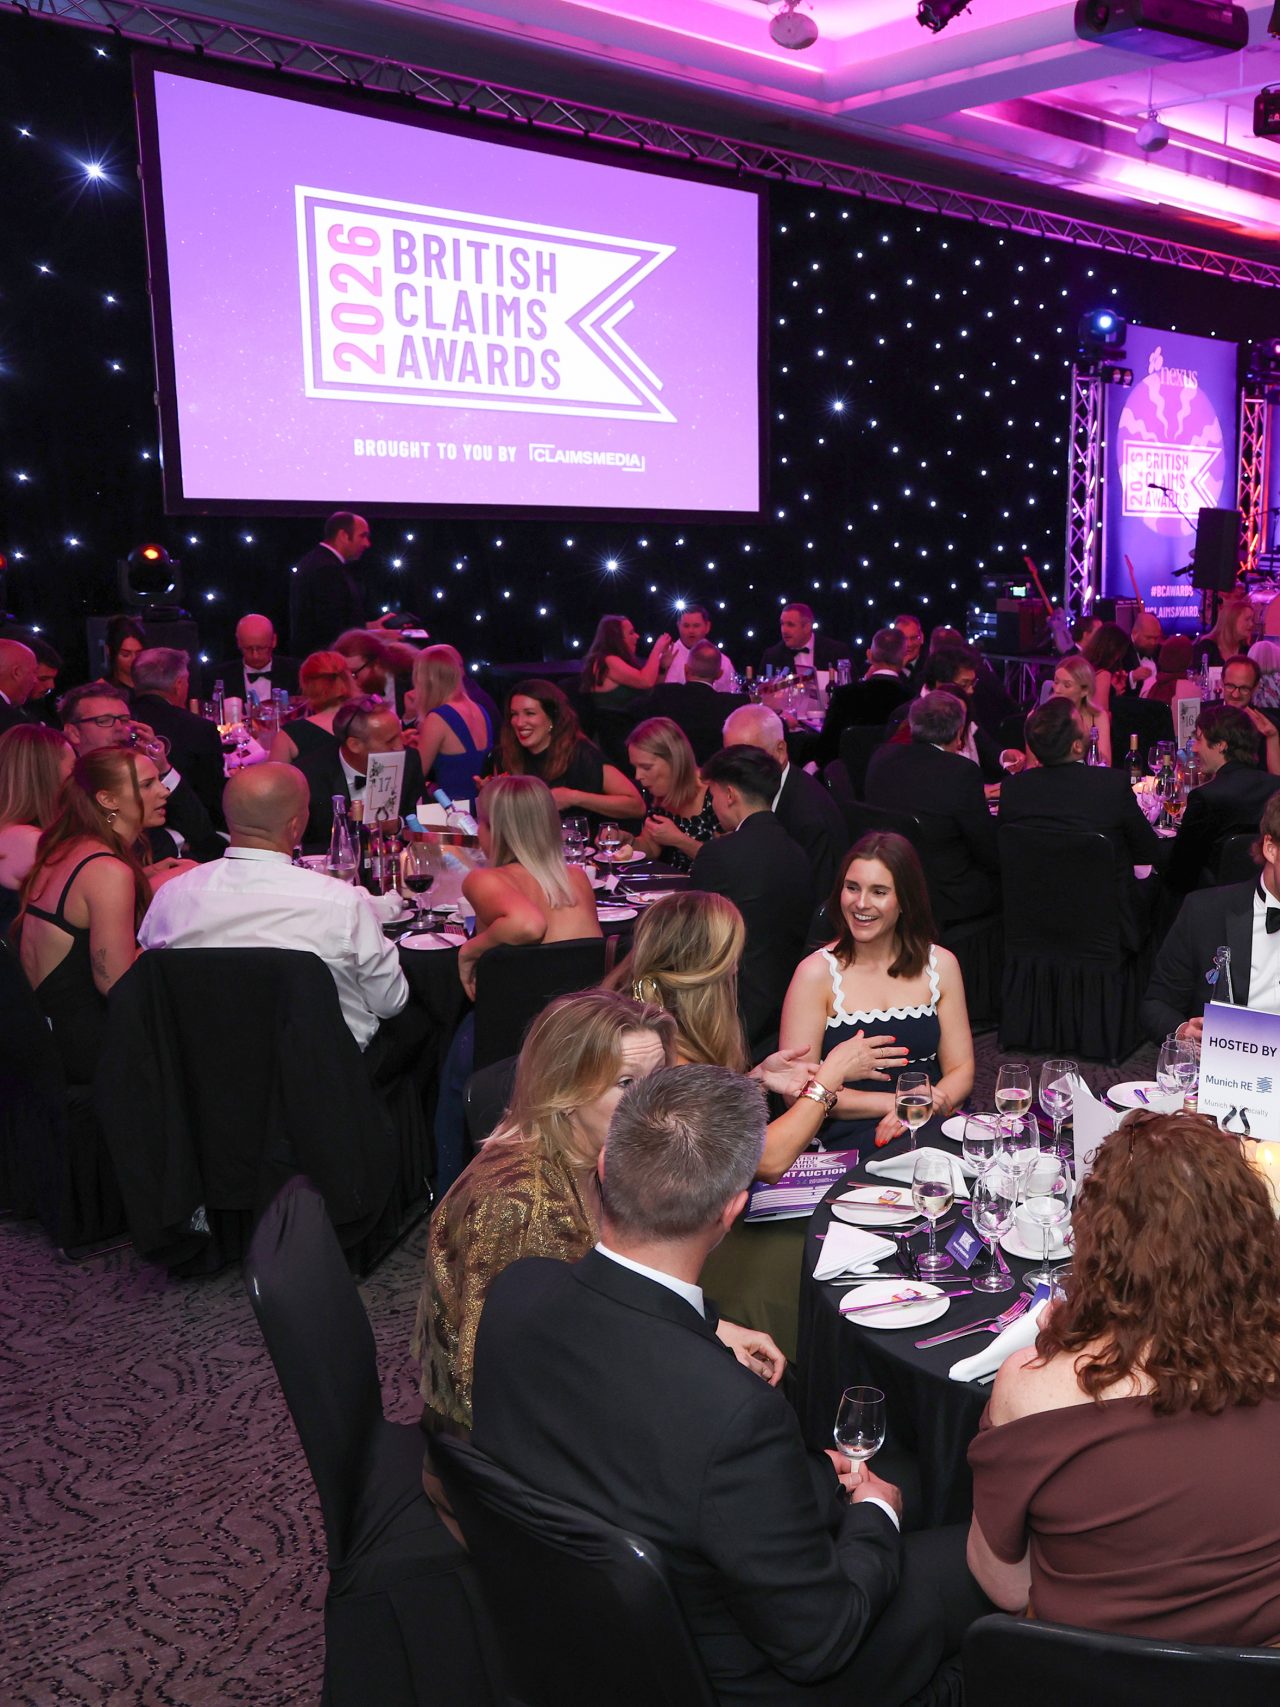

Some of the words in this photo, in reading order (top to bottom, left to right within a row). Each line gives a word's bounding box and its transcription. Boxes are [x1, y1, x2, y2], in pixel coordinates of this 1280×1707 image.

[392, 228, 558, 294] BRITISH
[327, 223, 386, 375] 2026
[394, 281, 548, 341] CLAIMS
[396, 334, 561, 391] AWARDS
[1161, 366, 1198, 389] nexus
[353, 438, 431, 459] BROUGHT
[436, 442, 458, 460] TO
[462, 443, 493, 462] YOU
[498, 445, 517, 463] BY
[533, 447, 641, 468] CLAIMSMEDIA
[1145, 451, 1189, 471] BRITISH
[1150, 584, 1194, 597] #BCAWARDS
[1185, 714, 1195, 727] 16
[378, 776, 392, 793] 17
[1209, 1036, 1259, 1055] HOSTED
[1261, 1045, 1278, 1058] BY
[1205, 1074, 1239, 1089] Munich
[1240, 1080, 1254, 1092] RE
[1204, 1098, 1228, 1109] Munich
[798, 1167, 847, 1178] AUCTION
